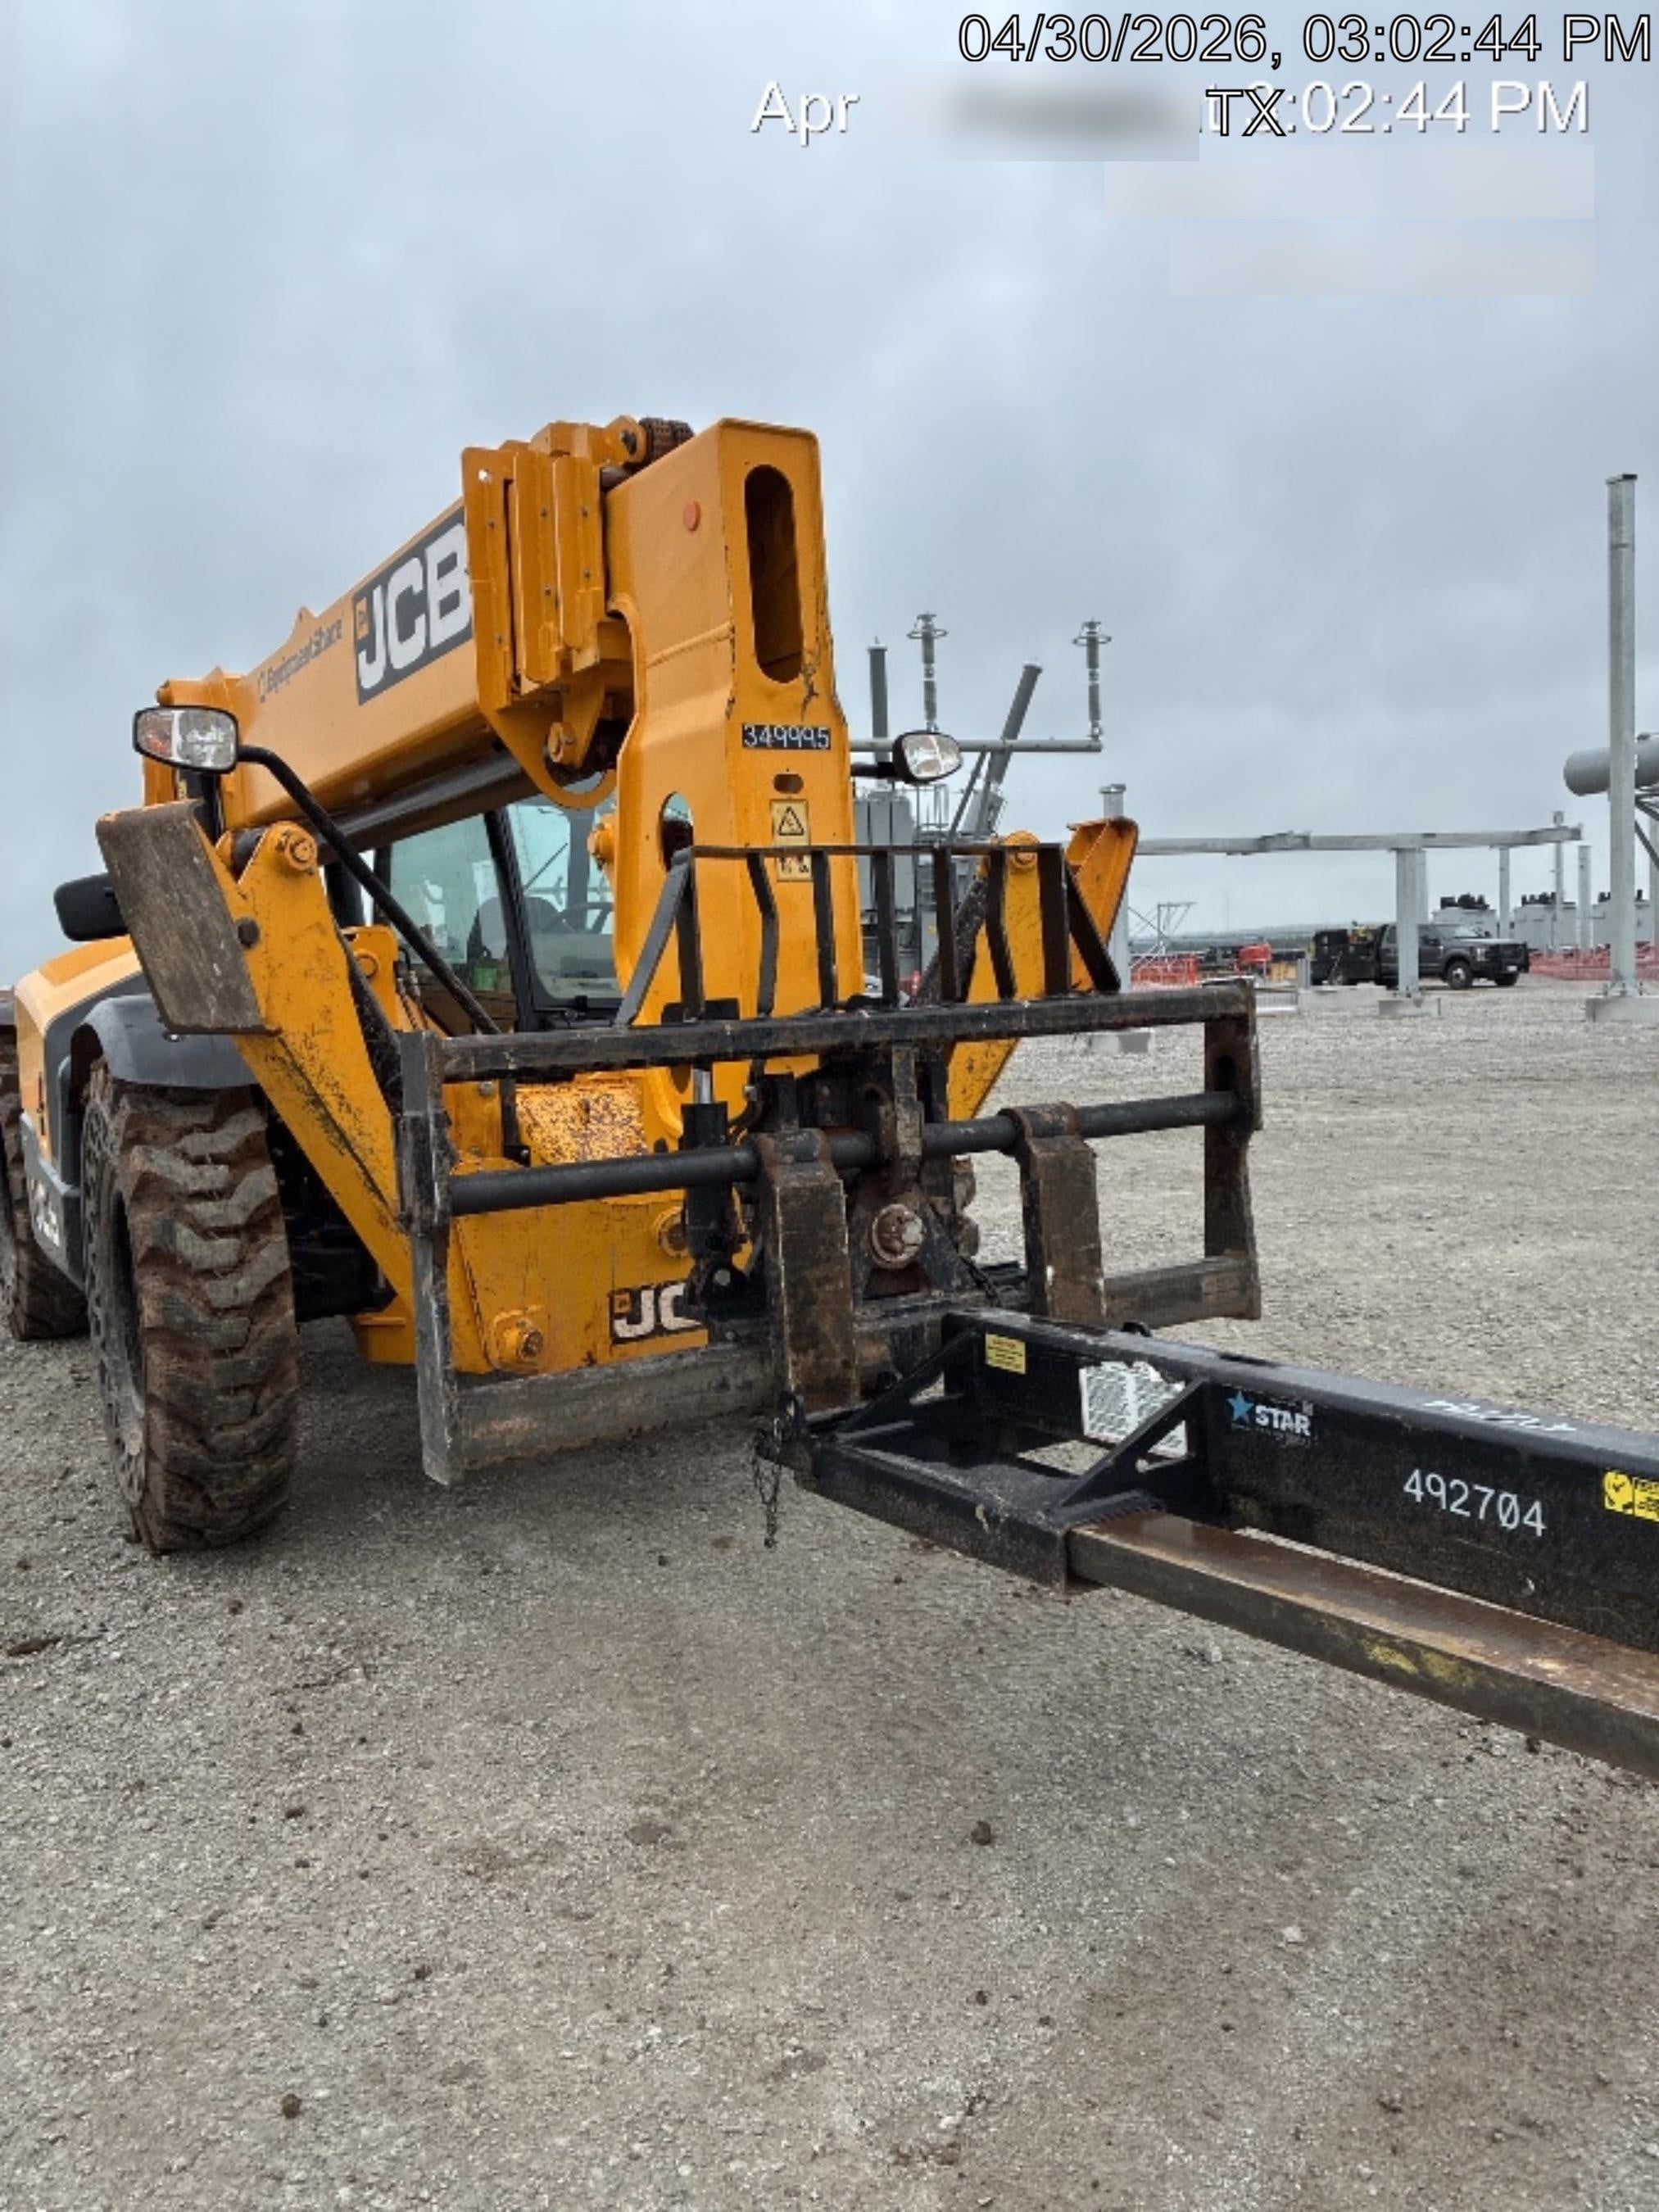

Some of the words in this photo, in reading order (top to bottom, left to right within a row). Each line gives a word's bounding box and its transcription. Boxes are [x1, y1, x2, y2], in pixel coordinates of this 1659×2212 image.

[358, 523, 472, 690] JCB
[743, 724, 829, 749] 349995
[614, 1282, 702, 1338] JC
[1255, 1404, 1311, 1436] STAR
[1403, 1469, 1547, 1537] 492704
